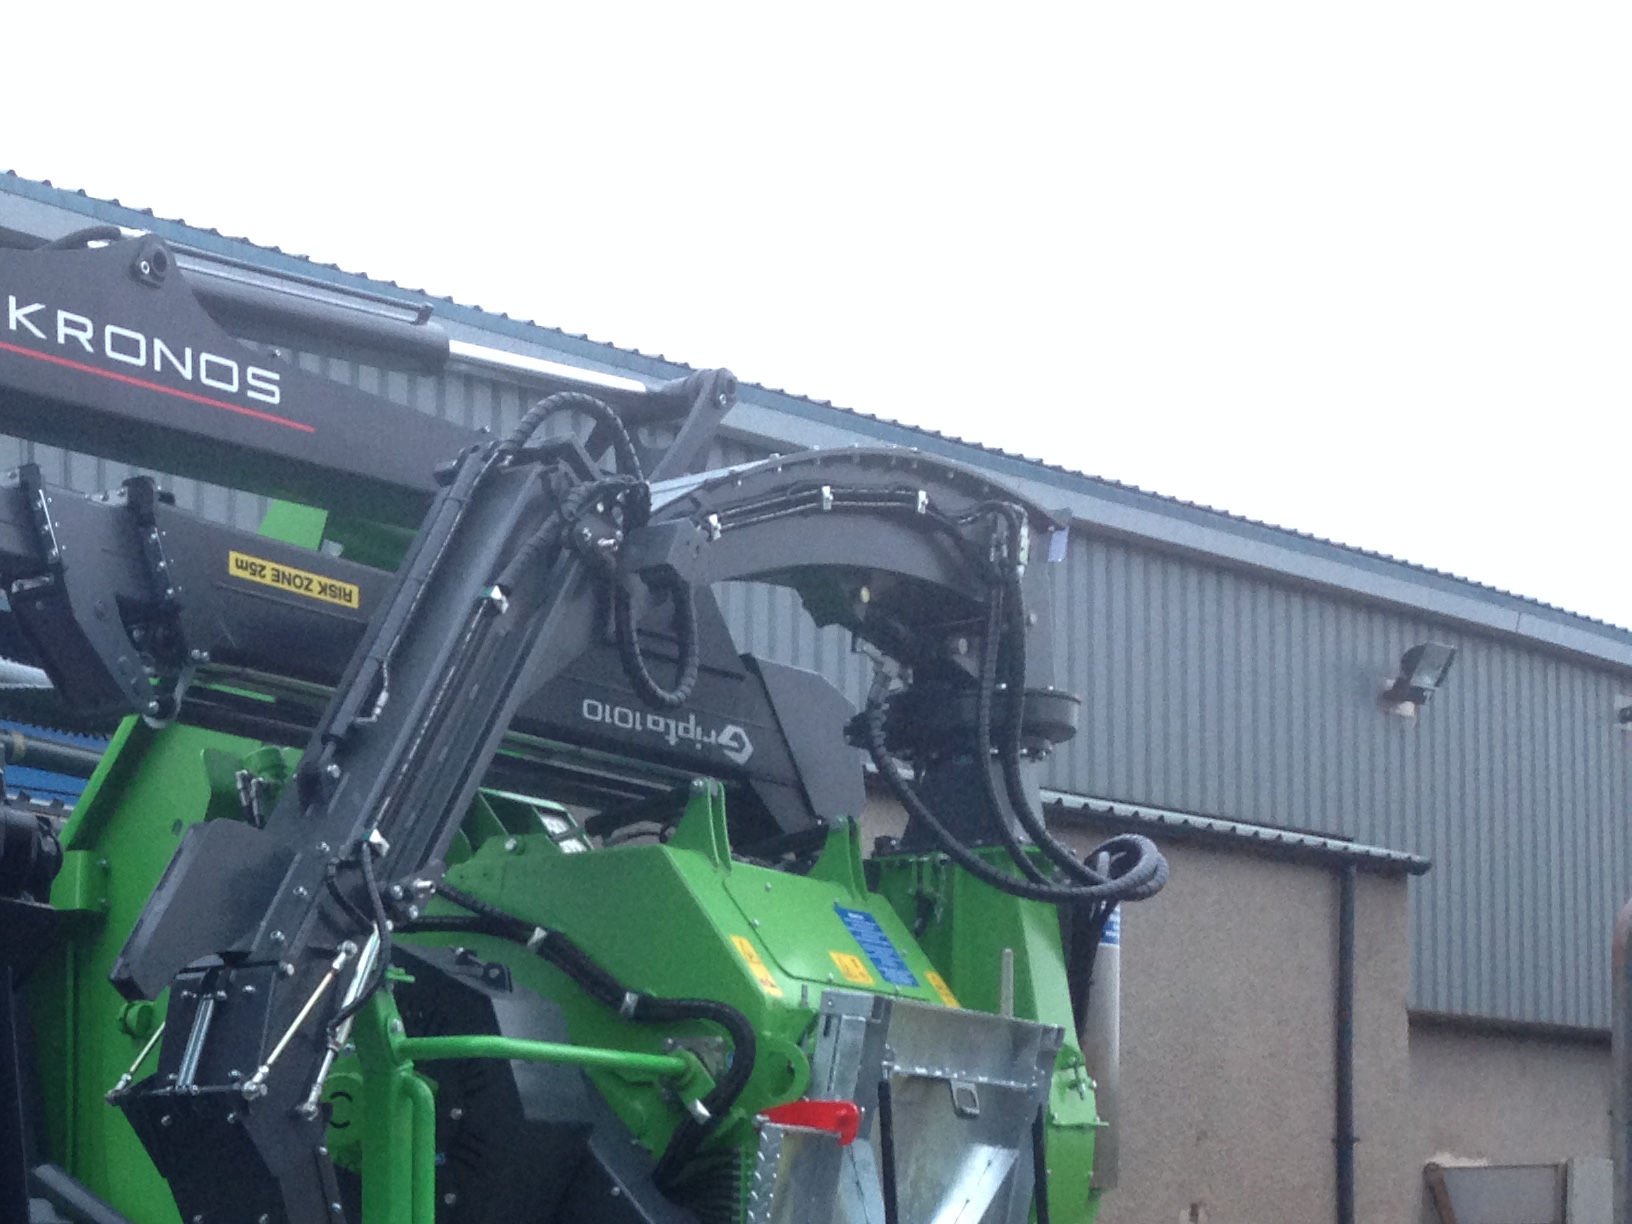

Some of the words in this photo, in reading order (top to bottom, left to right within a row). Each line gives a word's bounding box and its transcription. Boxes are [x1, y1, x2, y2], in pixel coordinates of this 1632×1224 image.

[7, 294, 281, 405] KRONOS
[235, 557, 267, 579] 25m
[271, 567, 314, 592] ZONE
[317, 580, 353, 603] RISK
